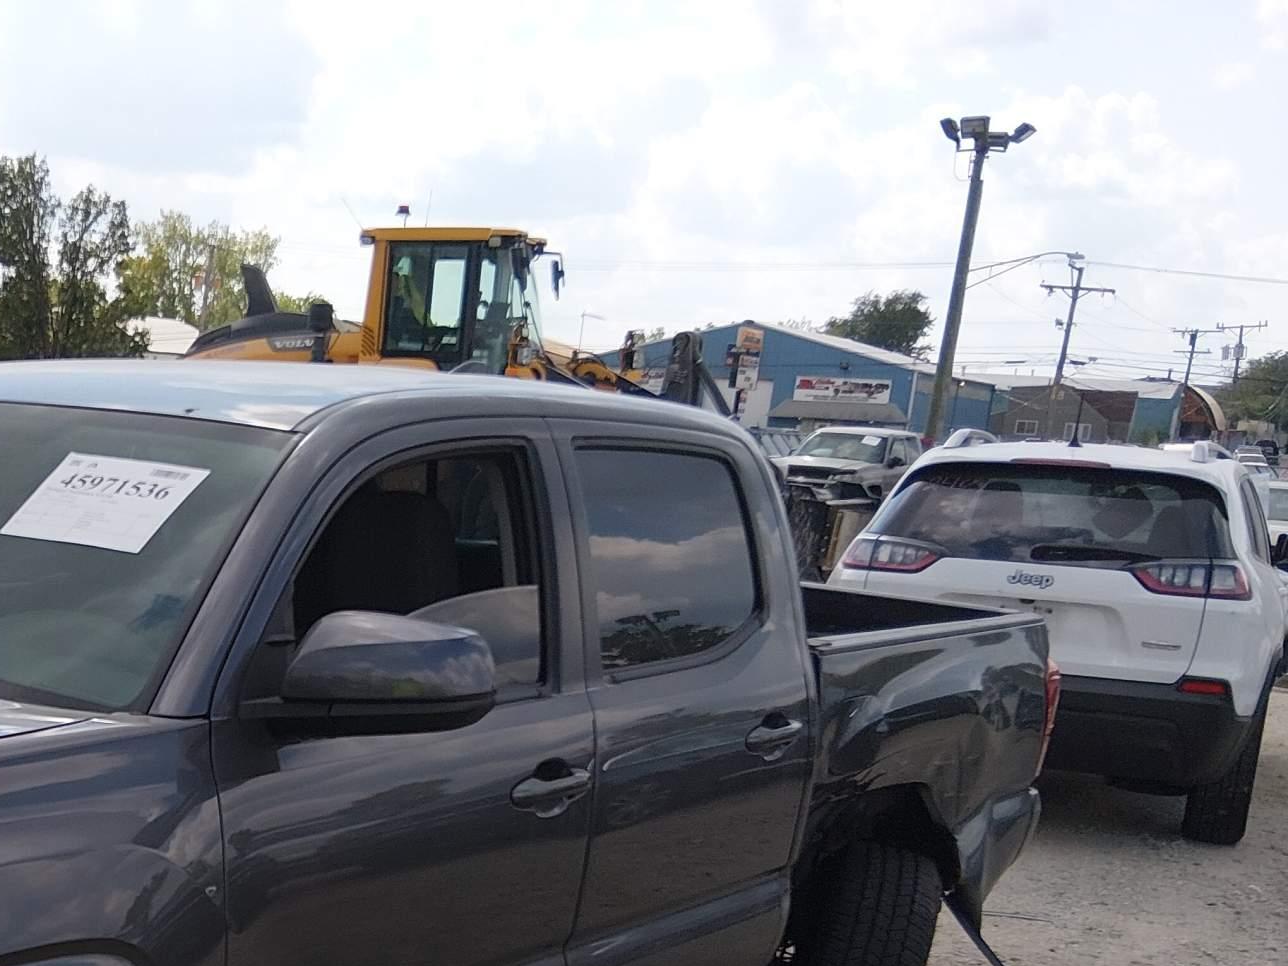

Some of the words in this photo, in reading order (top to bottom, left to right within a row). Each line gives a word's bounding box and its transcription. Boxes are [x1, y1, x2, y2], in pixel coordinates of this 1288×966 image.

[274, 339, 314, 348] VOLV
[61, 473, 171, 500] 45971536
[1006, 569, 1055, 590] Jeep
